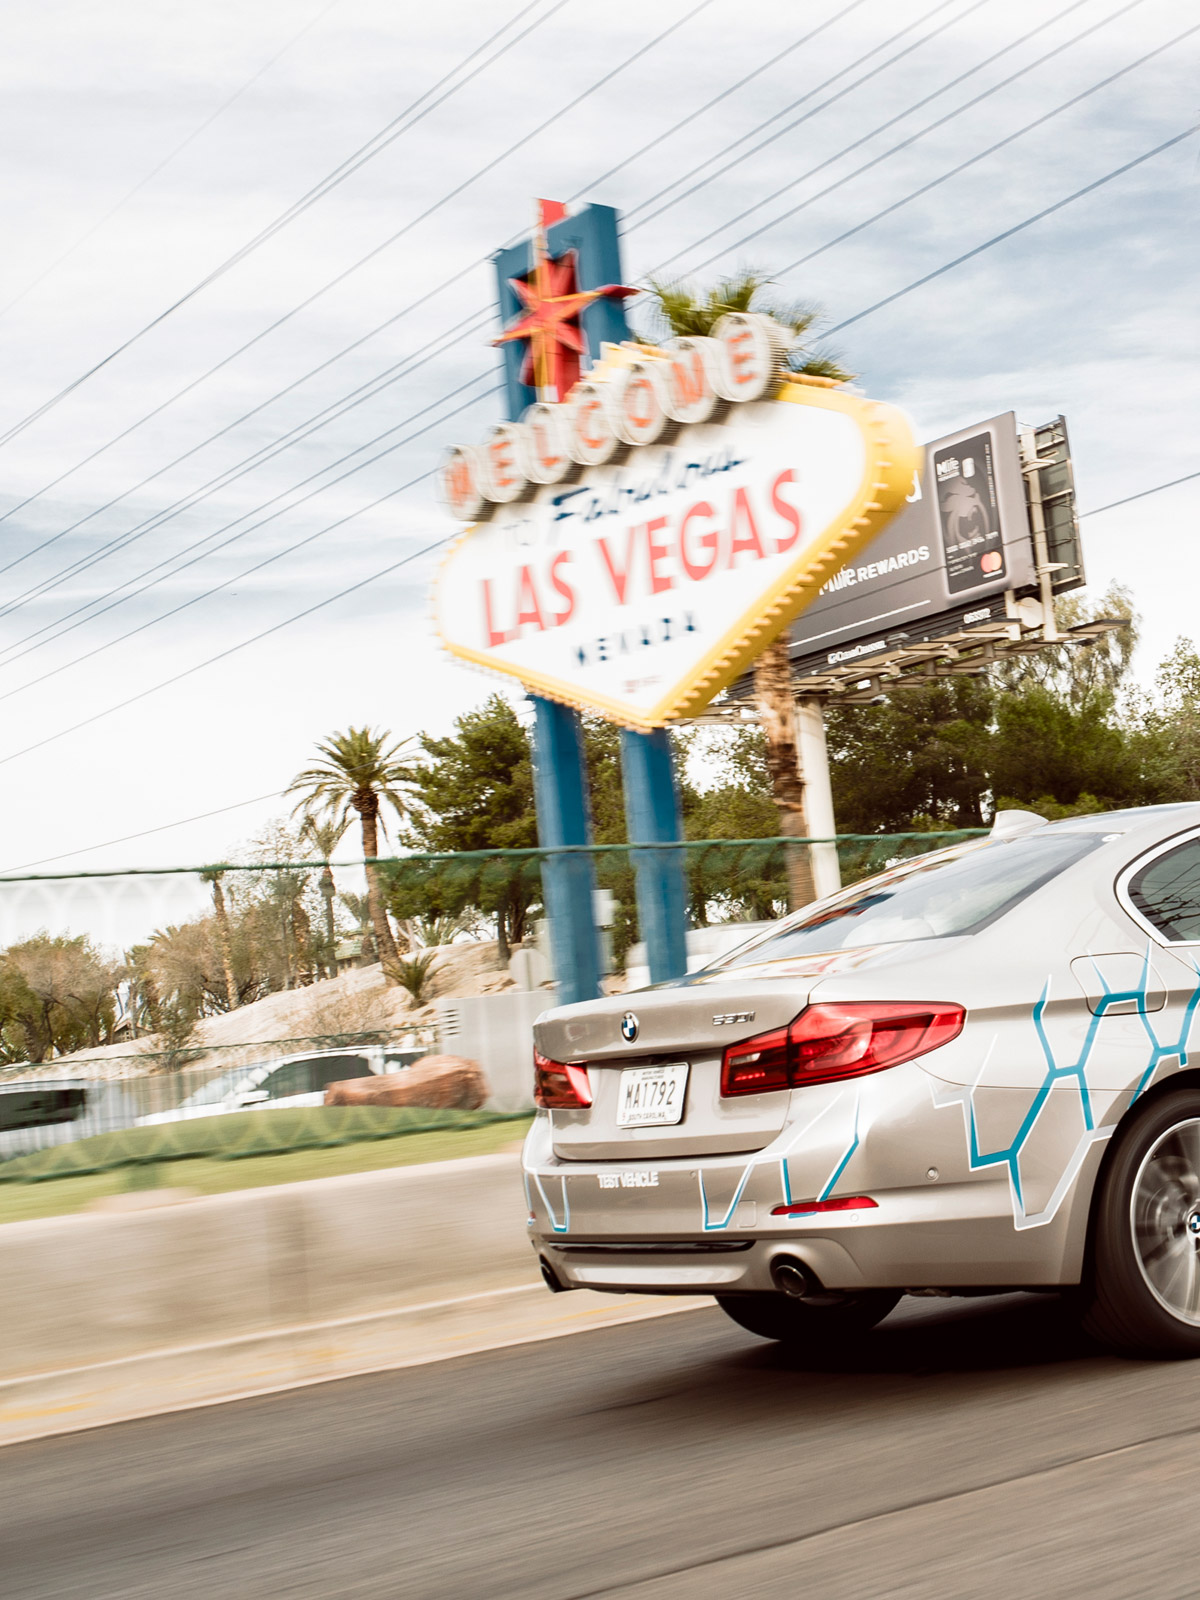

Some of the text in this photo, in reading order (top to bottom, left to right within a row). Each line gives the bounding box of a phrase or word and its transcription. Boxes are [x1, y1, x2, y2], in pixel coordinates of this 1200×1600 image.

[448, 328, 760, 511] WELCOME
[478, 467, 804, 650] LAS VEGAS
[857, 545, 930, 583] REWARDS
[597, 1171, 660, 1189] TEST VEHICLE
